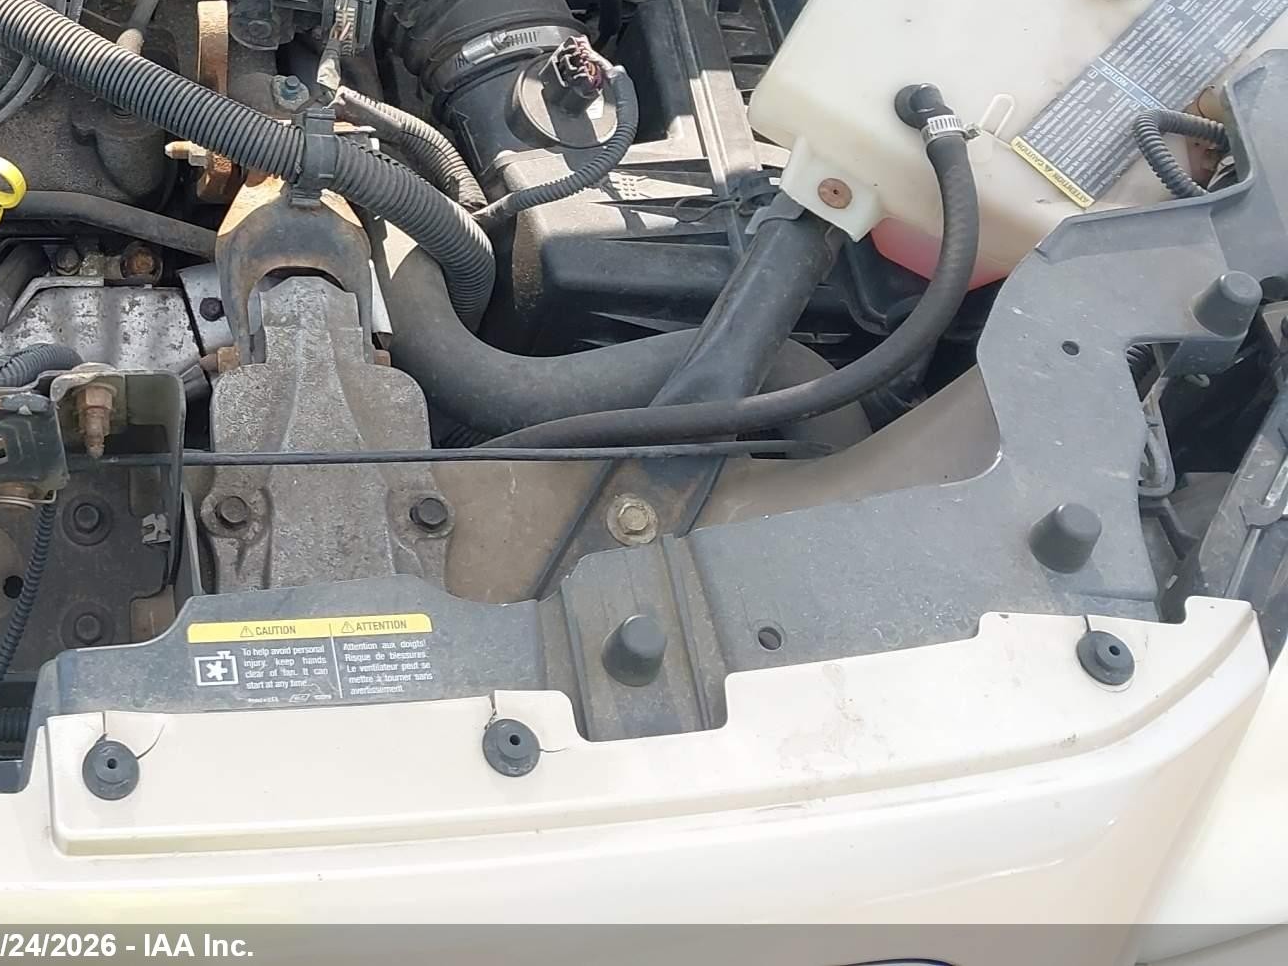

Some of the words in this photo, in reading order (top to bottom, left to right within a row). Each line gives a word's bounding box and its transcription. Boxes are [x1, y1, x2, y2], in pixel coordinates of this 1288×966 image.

[255, 625, 296, 635] CAUTION
[356, 620, 407, 631] ATTENTION
[240, 648, 251, 656] To
[253, 648, 269, 657] help
[271, 646, 291, 655] avoid
[293, 645, 324, 655] personal
[344, 642, 378, 650] Attention
[275, 657, 295, 666] keep
[302, 656, 327, 664] hands
[345, 654, 371, 662] Risque
[375, 652, 385, 660] de
[347, 665, 356, 673] Le
[359, 663, 398, 672] ventilateur
[401, 662, 418, 671] peut
[245, 670, 264, 678] clear
[270, 669, 278, 677] of
[349, 675, 373, 684] mettre
[384, 674, 411, 682] tourner
[414, 673, 433, 681] sans
[246, 681, 264, 689] start
[275, 681, 288, 689] any
